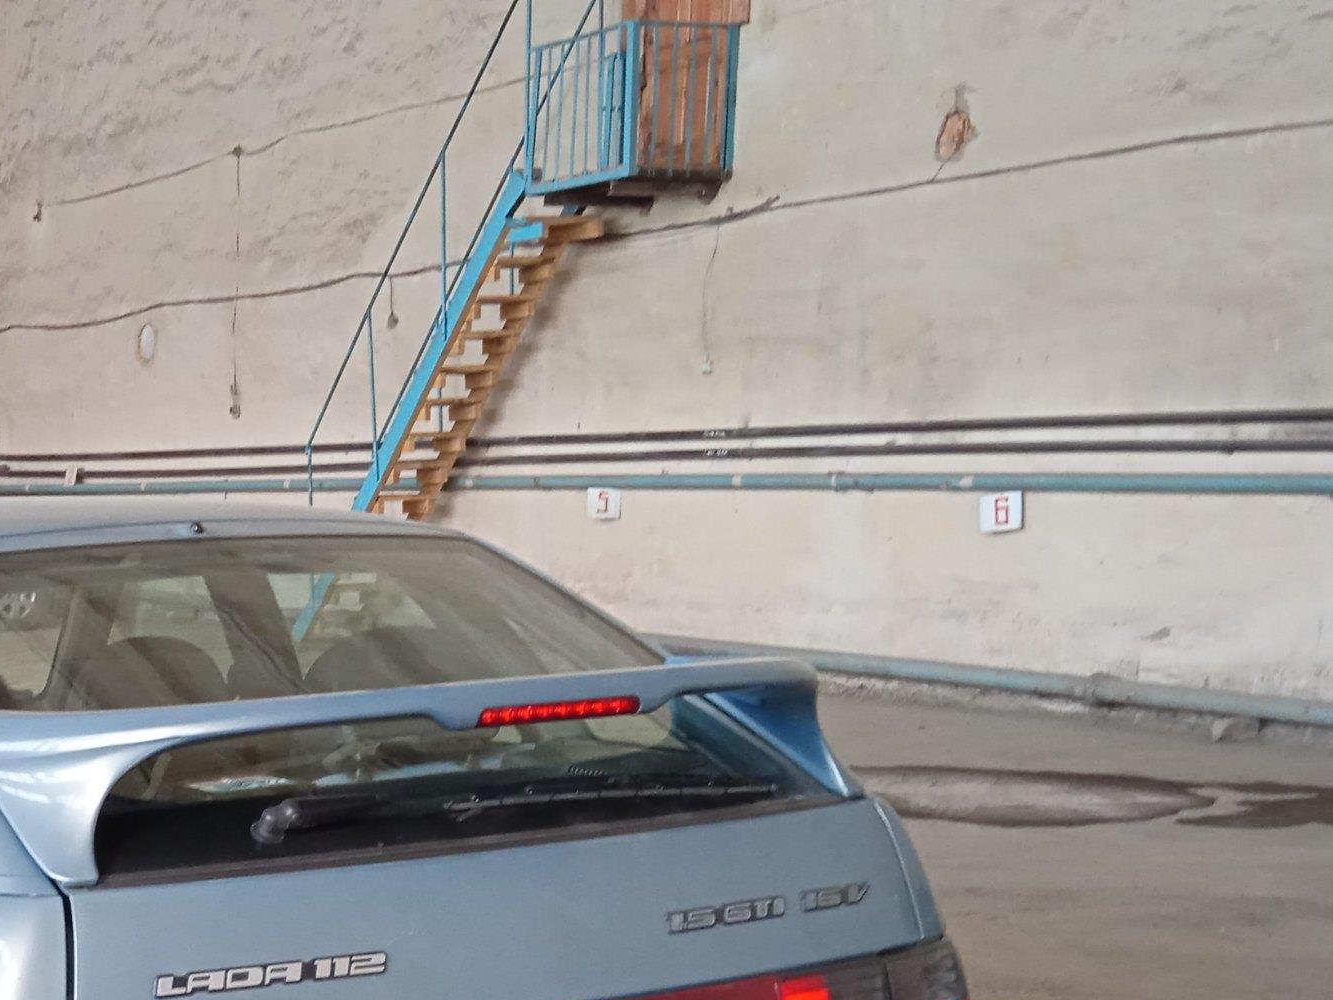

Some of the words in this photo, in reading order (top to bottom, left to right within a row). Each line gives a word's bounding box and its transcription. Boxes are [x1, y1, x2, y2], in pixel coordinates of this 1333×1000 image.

[995, 497, 1008, 524] 6
[155, 960, 303, 998] LADA
[313, 951, 387, 980] 112
